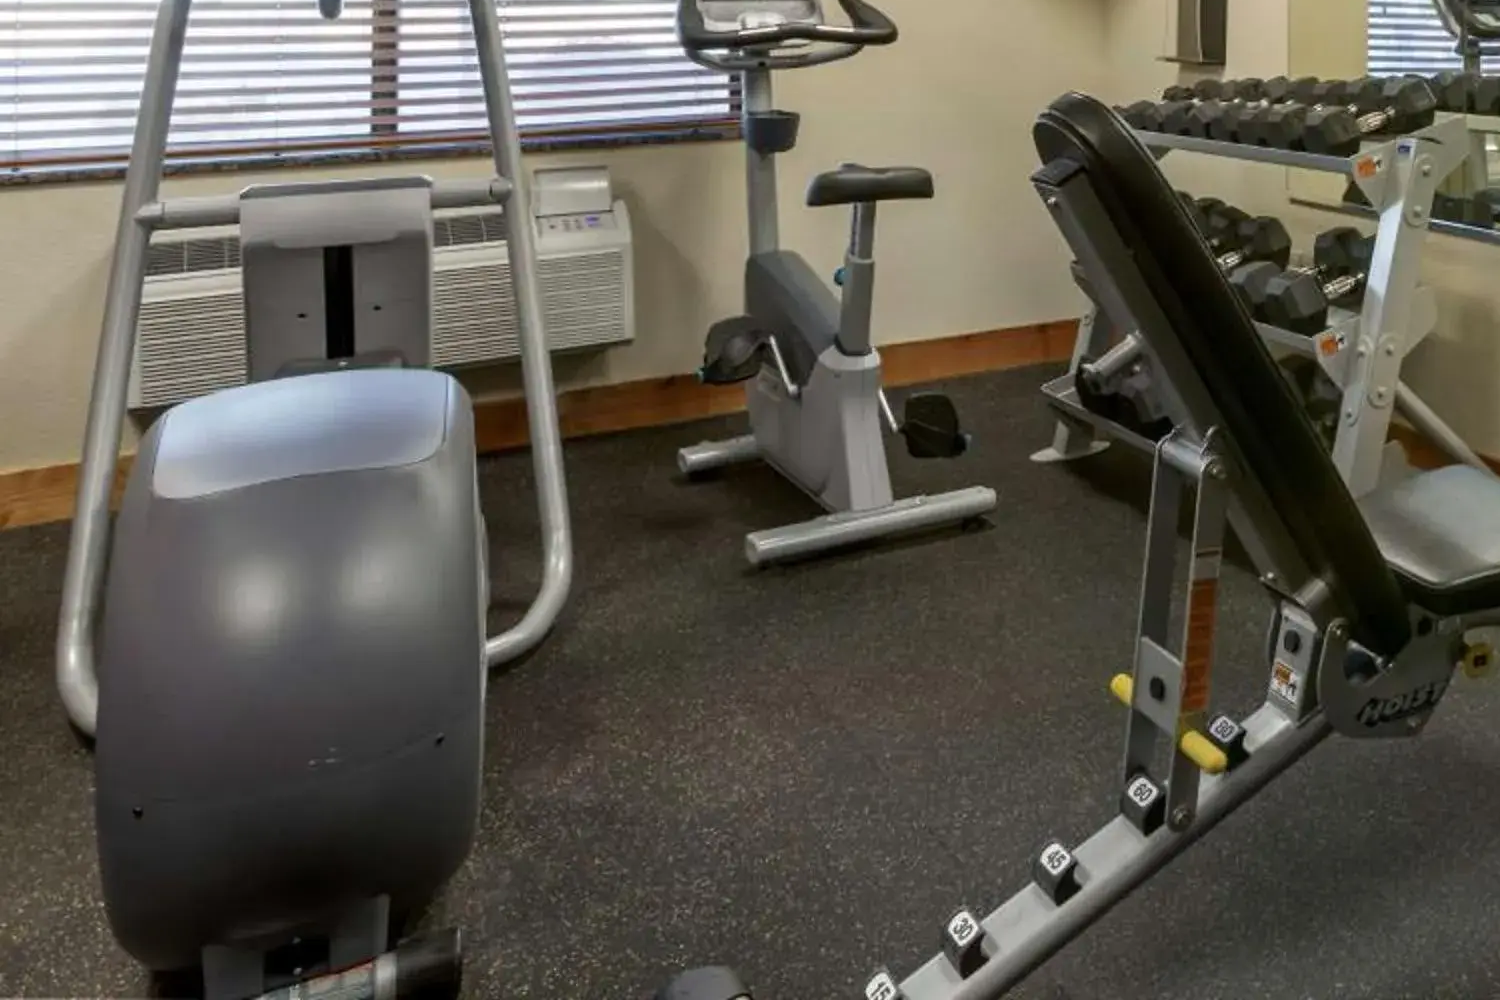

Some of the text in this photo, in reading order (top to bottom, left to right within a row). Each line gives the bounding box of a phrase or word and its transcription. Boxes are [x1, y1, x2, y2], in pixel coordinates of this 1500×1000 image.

[1359, 680, 1447, 724] HOIST
[1215, 719, 1235, 739] 80
[1133, 783, 1153, 802] 60
[1047, 850, 1067, 870] 45
[952, 917, 974, 941] 30
